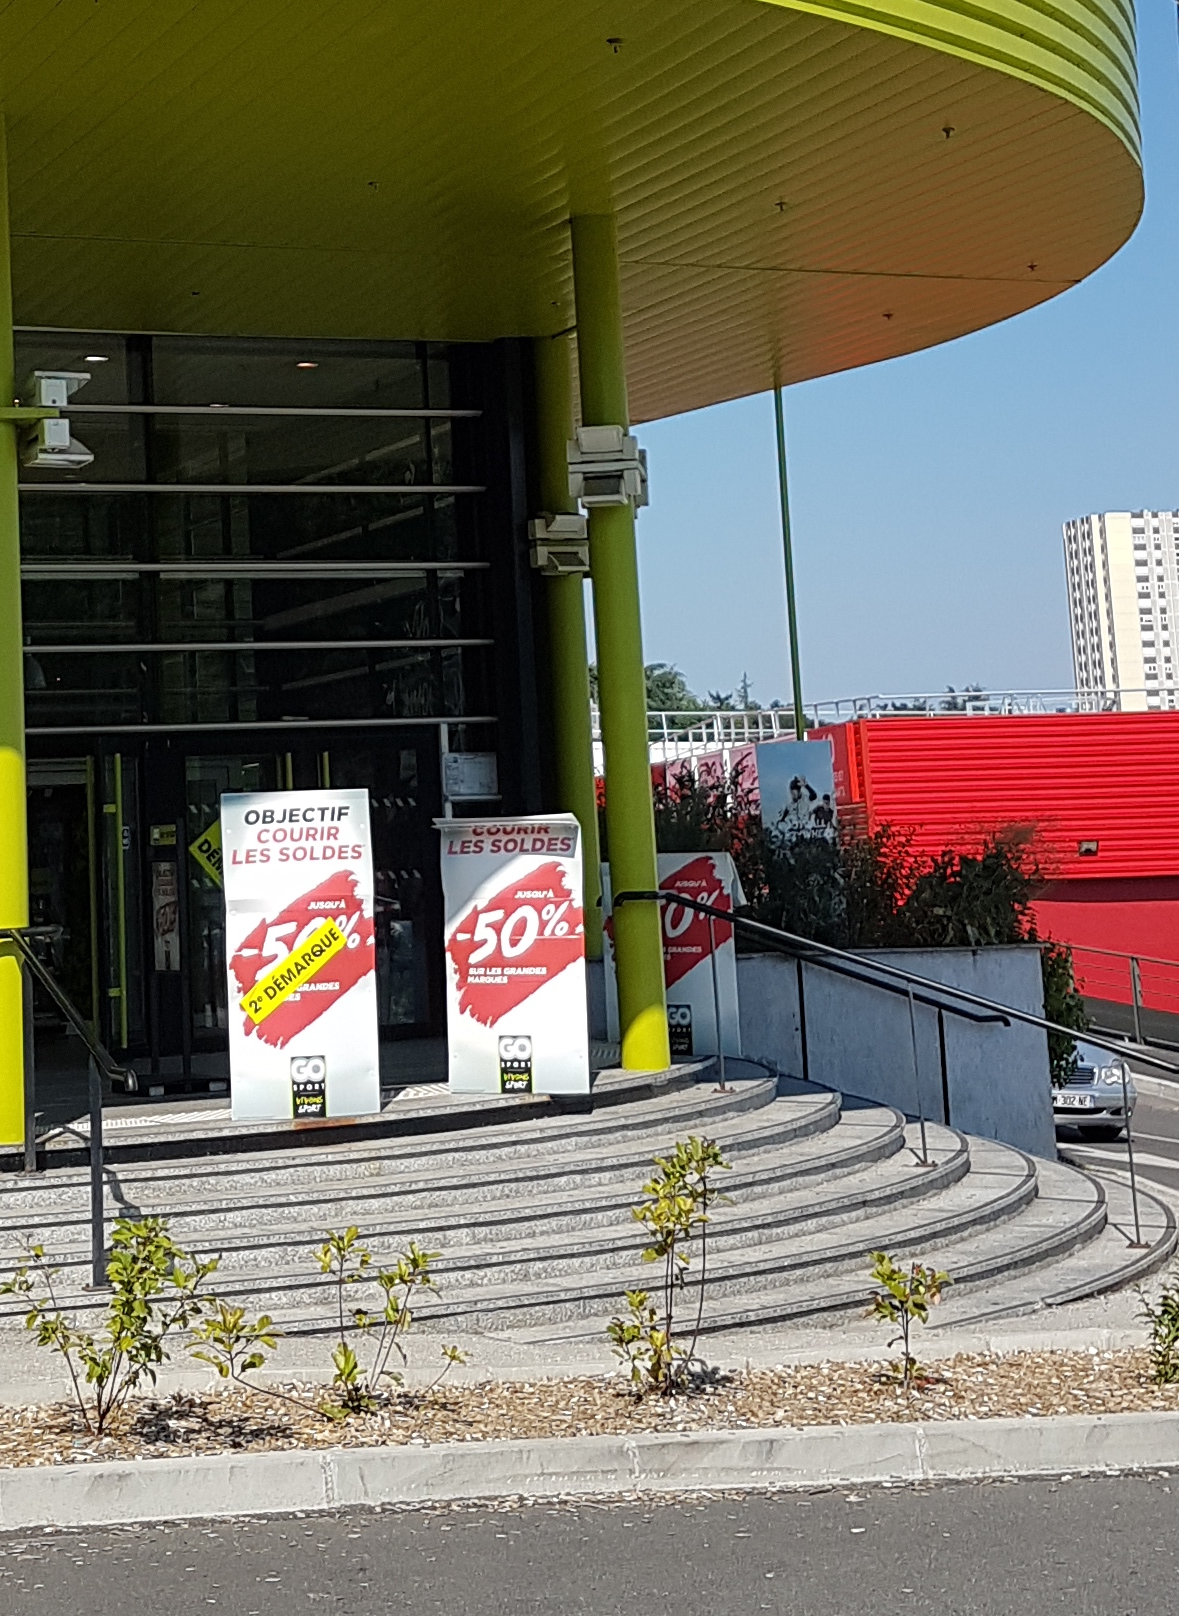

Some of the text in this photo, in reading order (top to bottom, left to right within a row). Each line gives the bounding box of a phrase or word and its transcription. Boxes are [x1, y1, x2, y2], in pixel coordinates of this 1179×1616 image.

[244, 805, 350, 826] OBJECTIF
[257, 825, 340, 844] COURIR
[231, 848, 271, 865] LES
[447, 839, 485, 855] LES
[456, 900, 571, 965] -50%
[263, 927, 340, 1001] DÉMARQUE
[486, 967, 502, 976] LES
[499, 1036, 532, 1060] GO
[291, 1057, 326, 1082] GO
